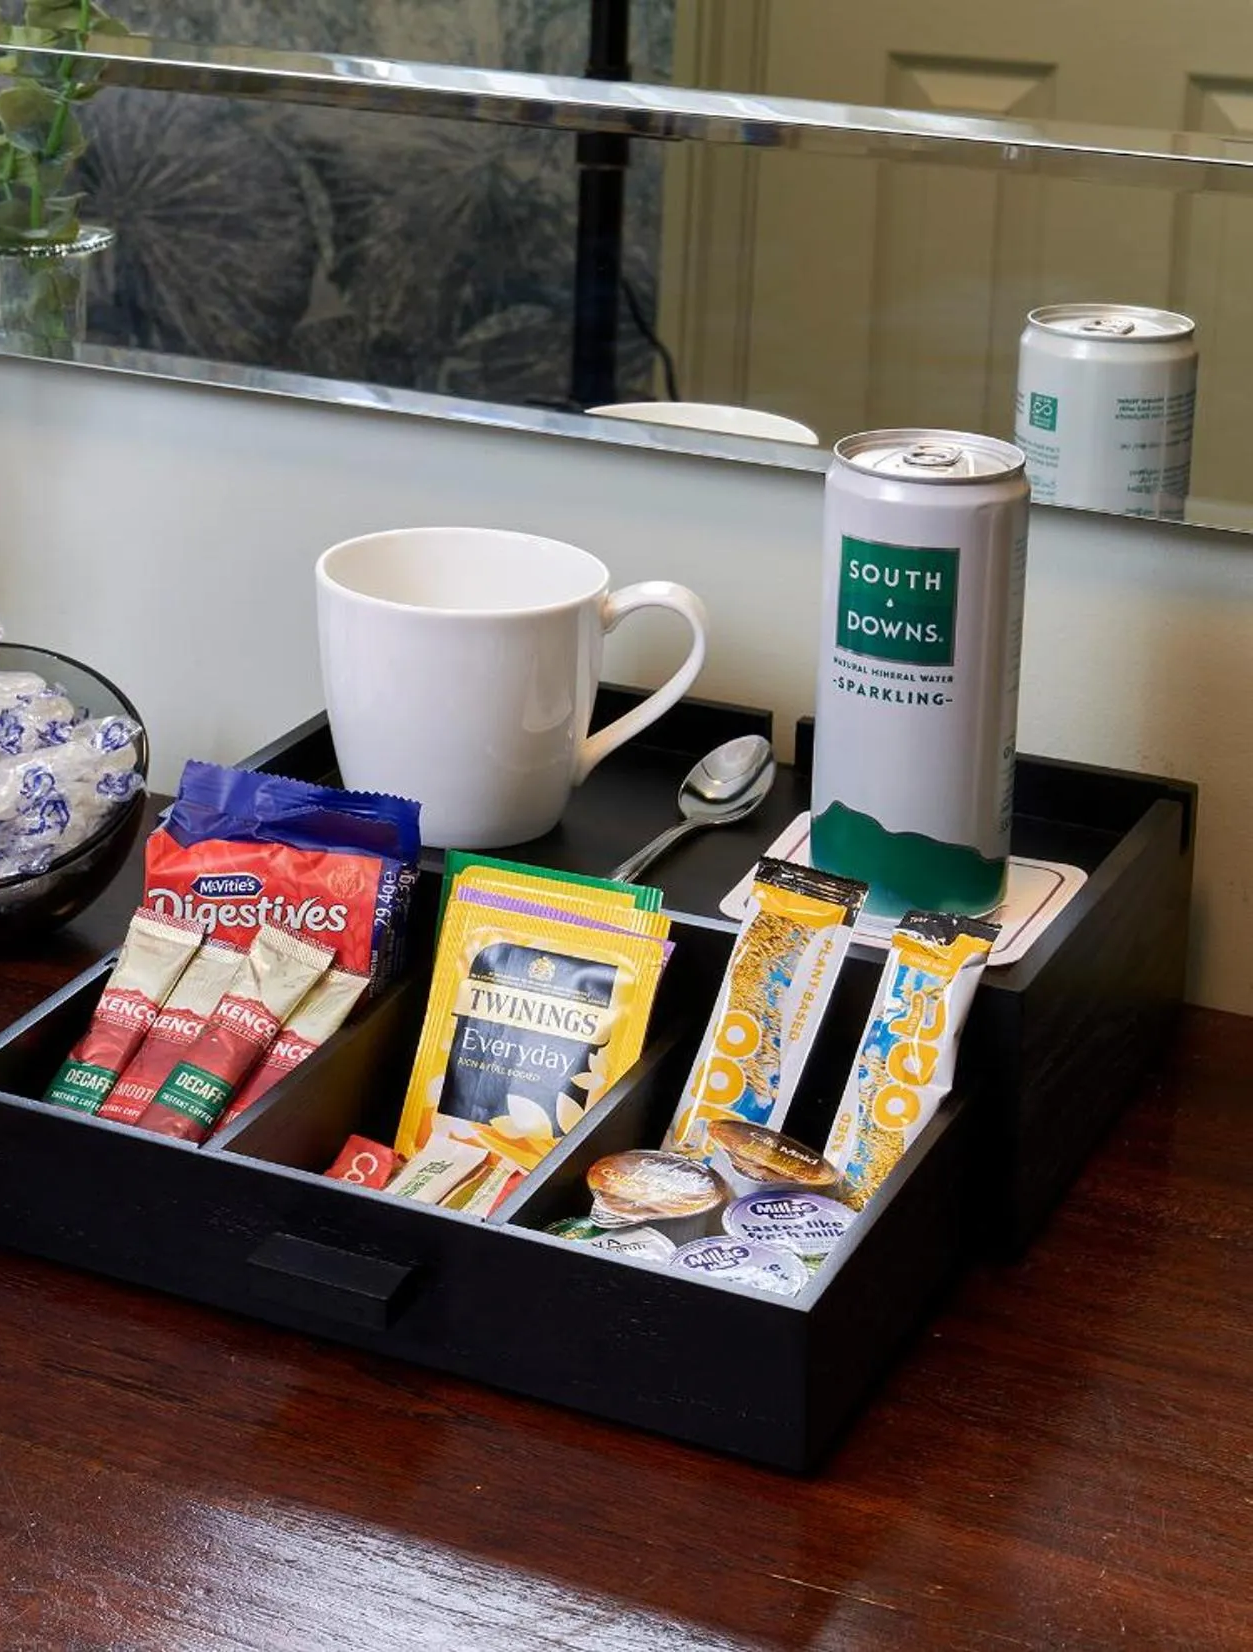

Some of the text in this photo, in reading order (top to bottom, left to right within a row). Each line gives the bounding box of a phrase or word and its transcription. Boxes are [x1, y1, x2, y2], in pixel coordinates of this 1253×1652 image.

[849, 560, 941, 591] SOUTH
[833, 656, 953, 683] NATURAL MINERAL WATER
[199, 878, 256, 893] McVitie's
[148, 888, 348, 934] Digestives
[96, 994, 157, 1025] KENCO
[217, 1001, 278, 1039] KENCO
[471, 988, 599, 1036] TWININGS
[789, 991, 815, 1041] BASED
[461, 1026, 576, 1077] Everyday
[64, 1068, 115, 1093] DECAFF
[175, 1071, 227, 1104] DECAFF
[755, 1200, 814, 1214] Millac
[741, 1219, 844, 1232] tastes like
[803, 1229, 846, 1239] milk
[688, 1246, 746, 1267] Millac
